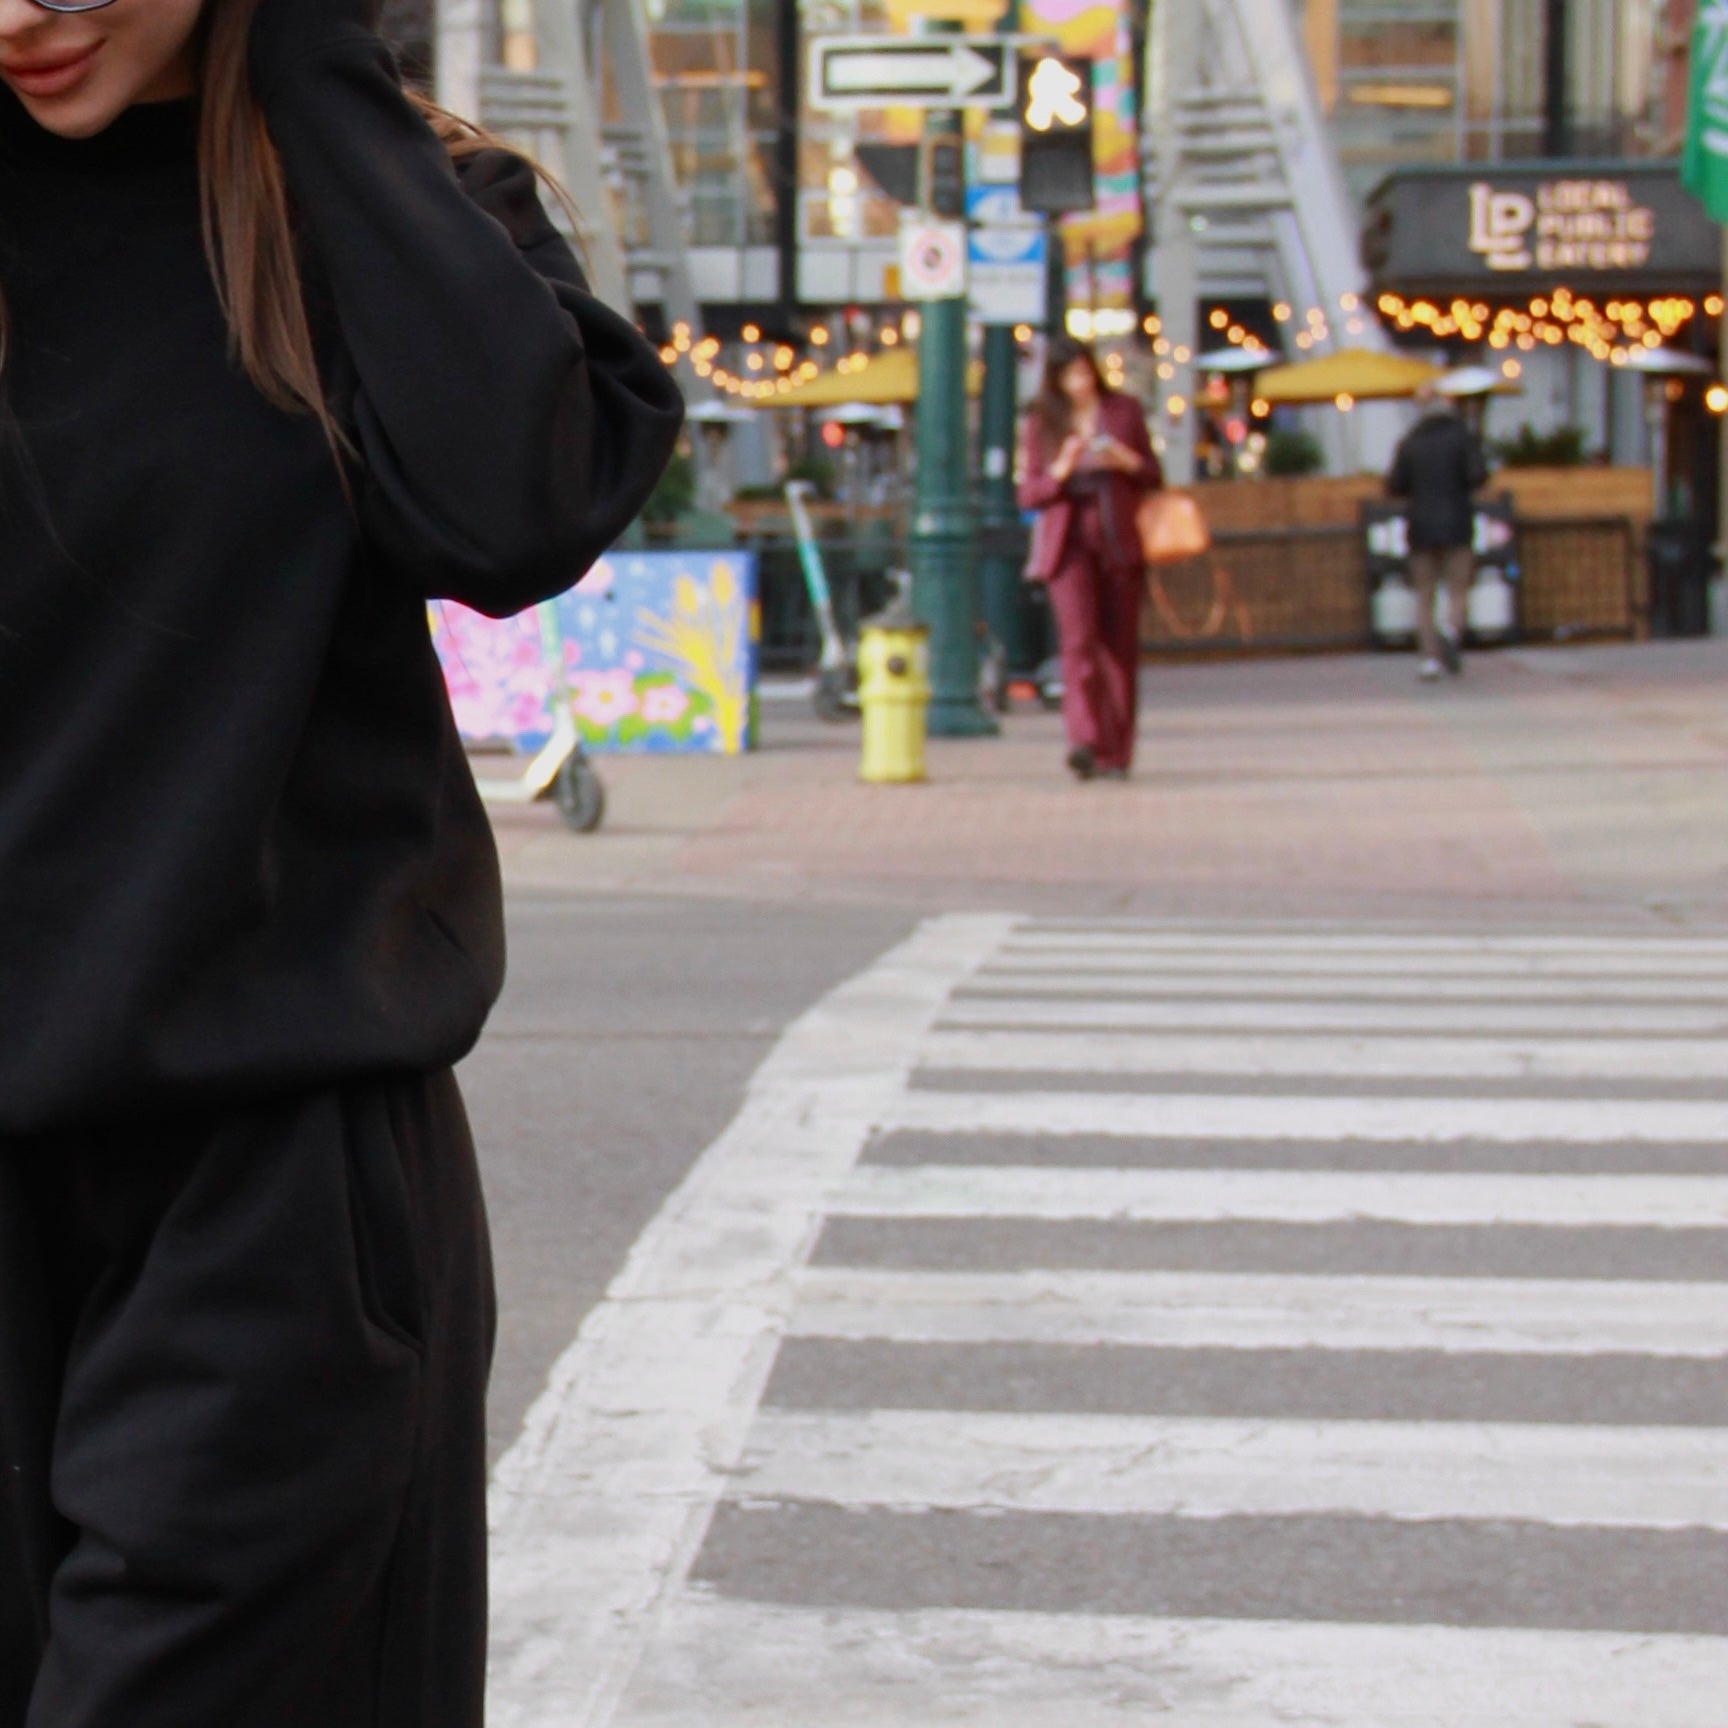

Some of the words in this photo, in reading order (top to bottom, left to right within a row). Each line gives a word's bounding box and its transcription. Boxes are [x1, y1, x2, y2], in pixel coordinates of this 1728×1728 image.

[1536, 180, 1630, 211] LOCAL
[1536, 208, 1654, 241] PUBLIC
[1536, 239, 1650, 270] EATERY
